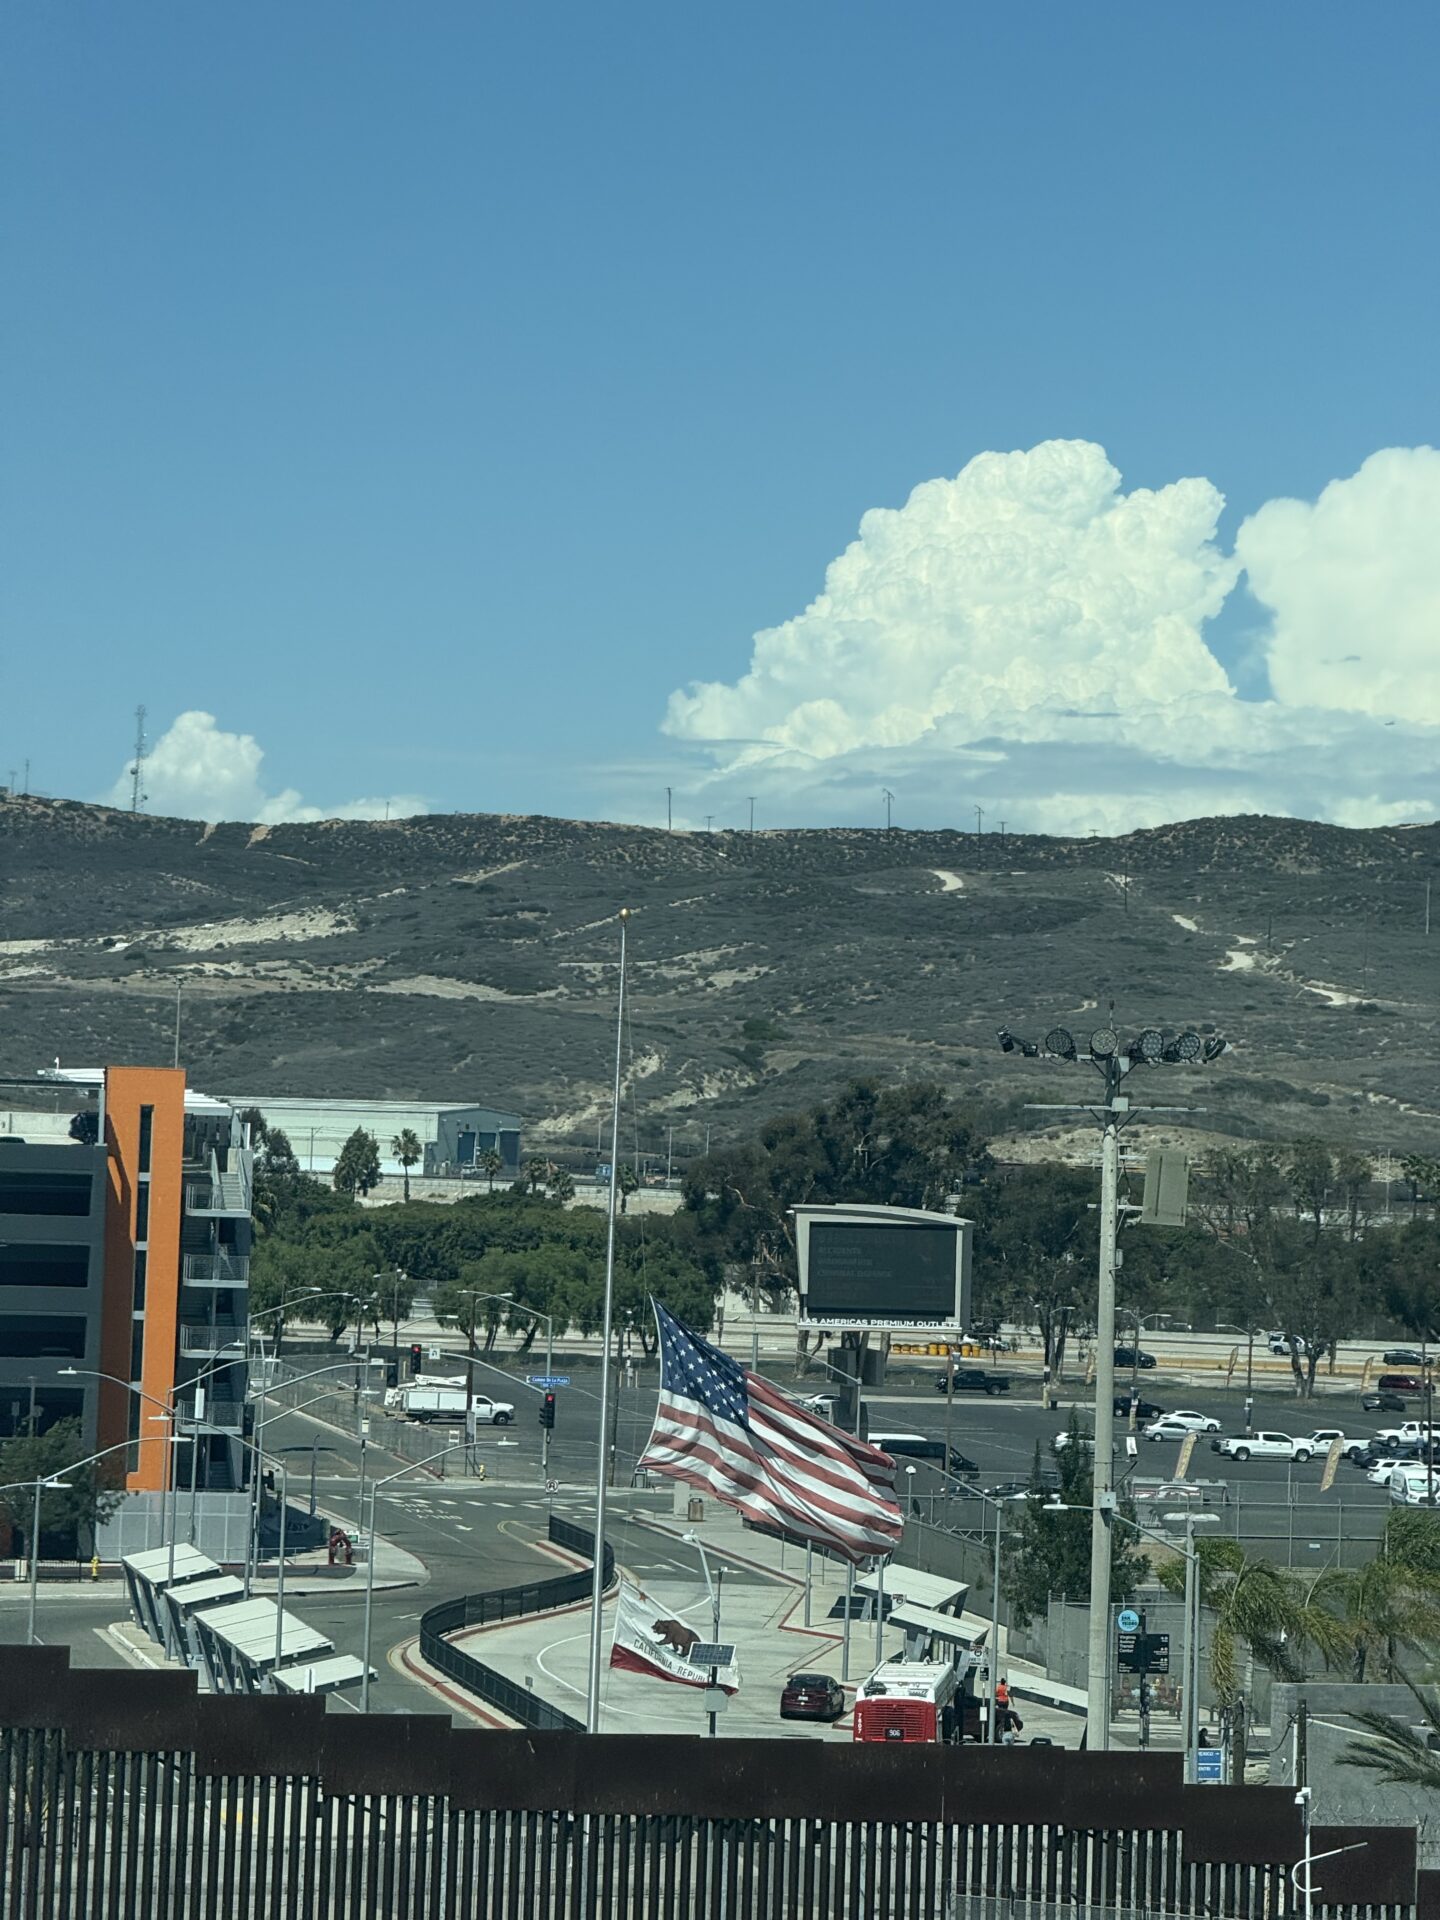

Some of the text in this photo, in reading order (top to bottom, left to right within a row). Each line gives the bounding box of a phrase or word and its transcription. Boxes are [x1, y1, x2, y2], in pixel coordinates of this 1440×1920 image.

[820, 1317, 868, 1325] AMERICAS
[870, 1319, 914, 1327] PREMIUM
[916, 1320, 959, 1328] OUTLETS
[633, 1639, 673, 1669] CALIFORNIA
